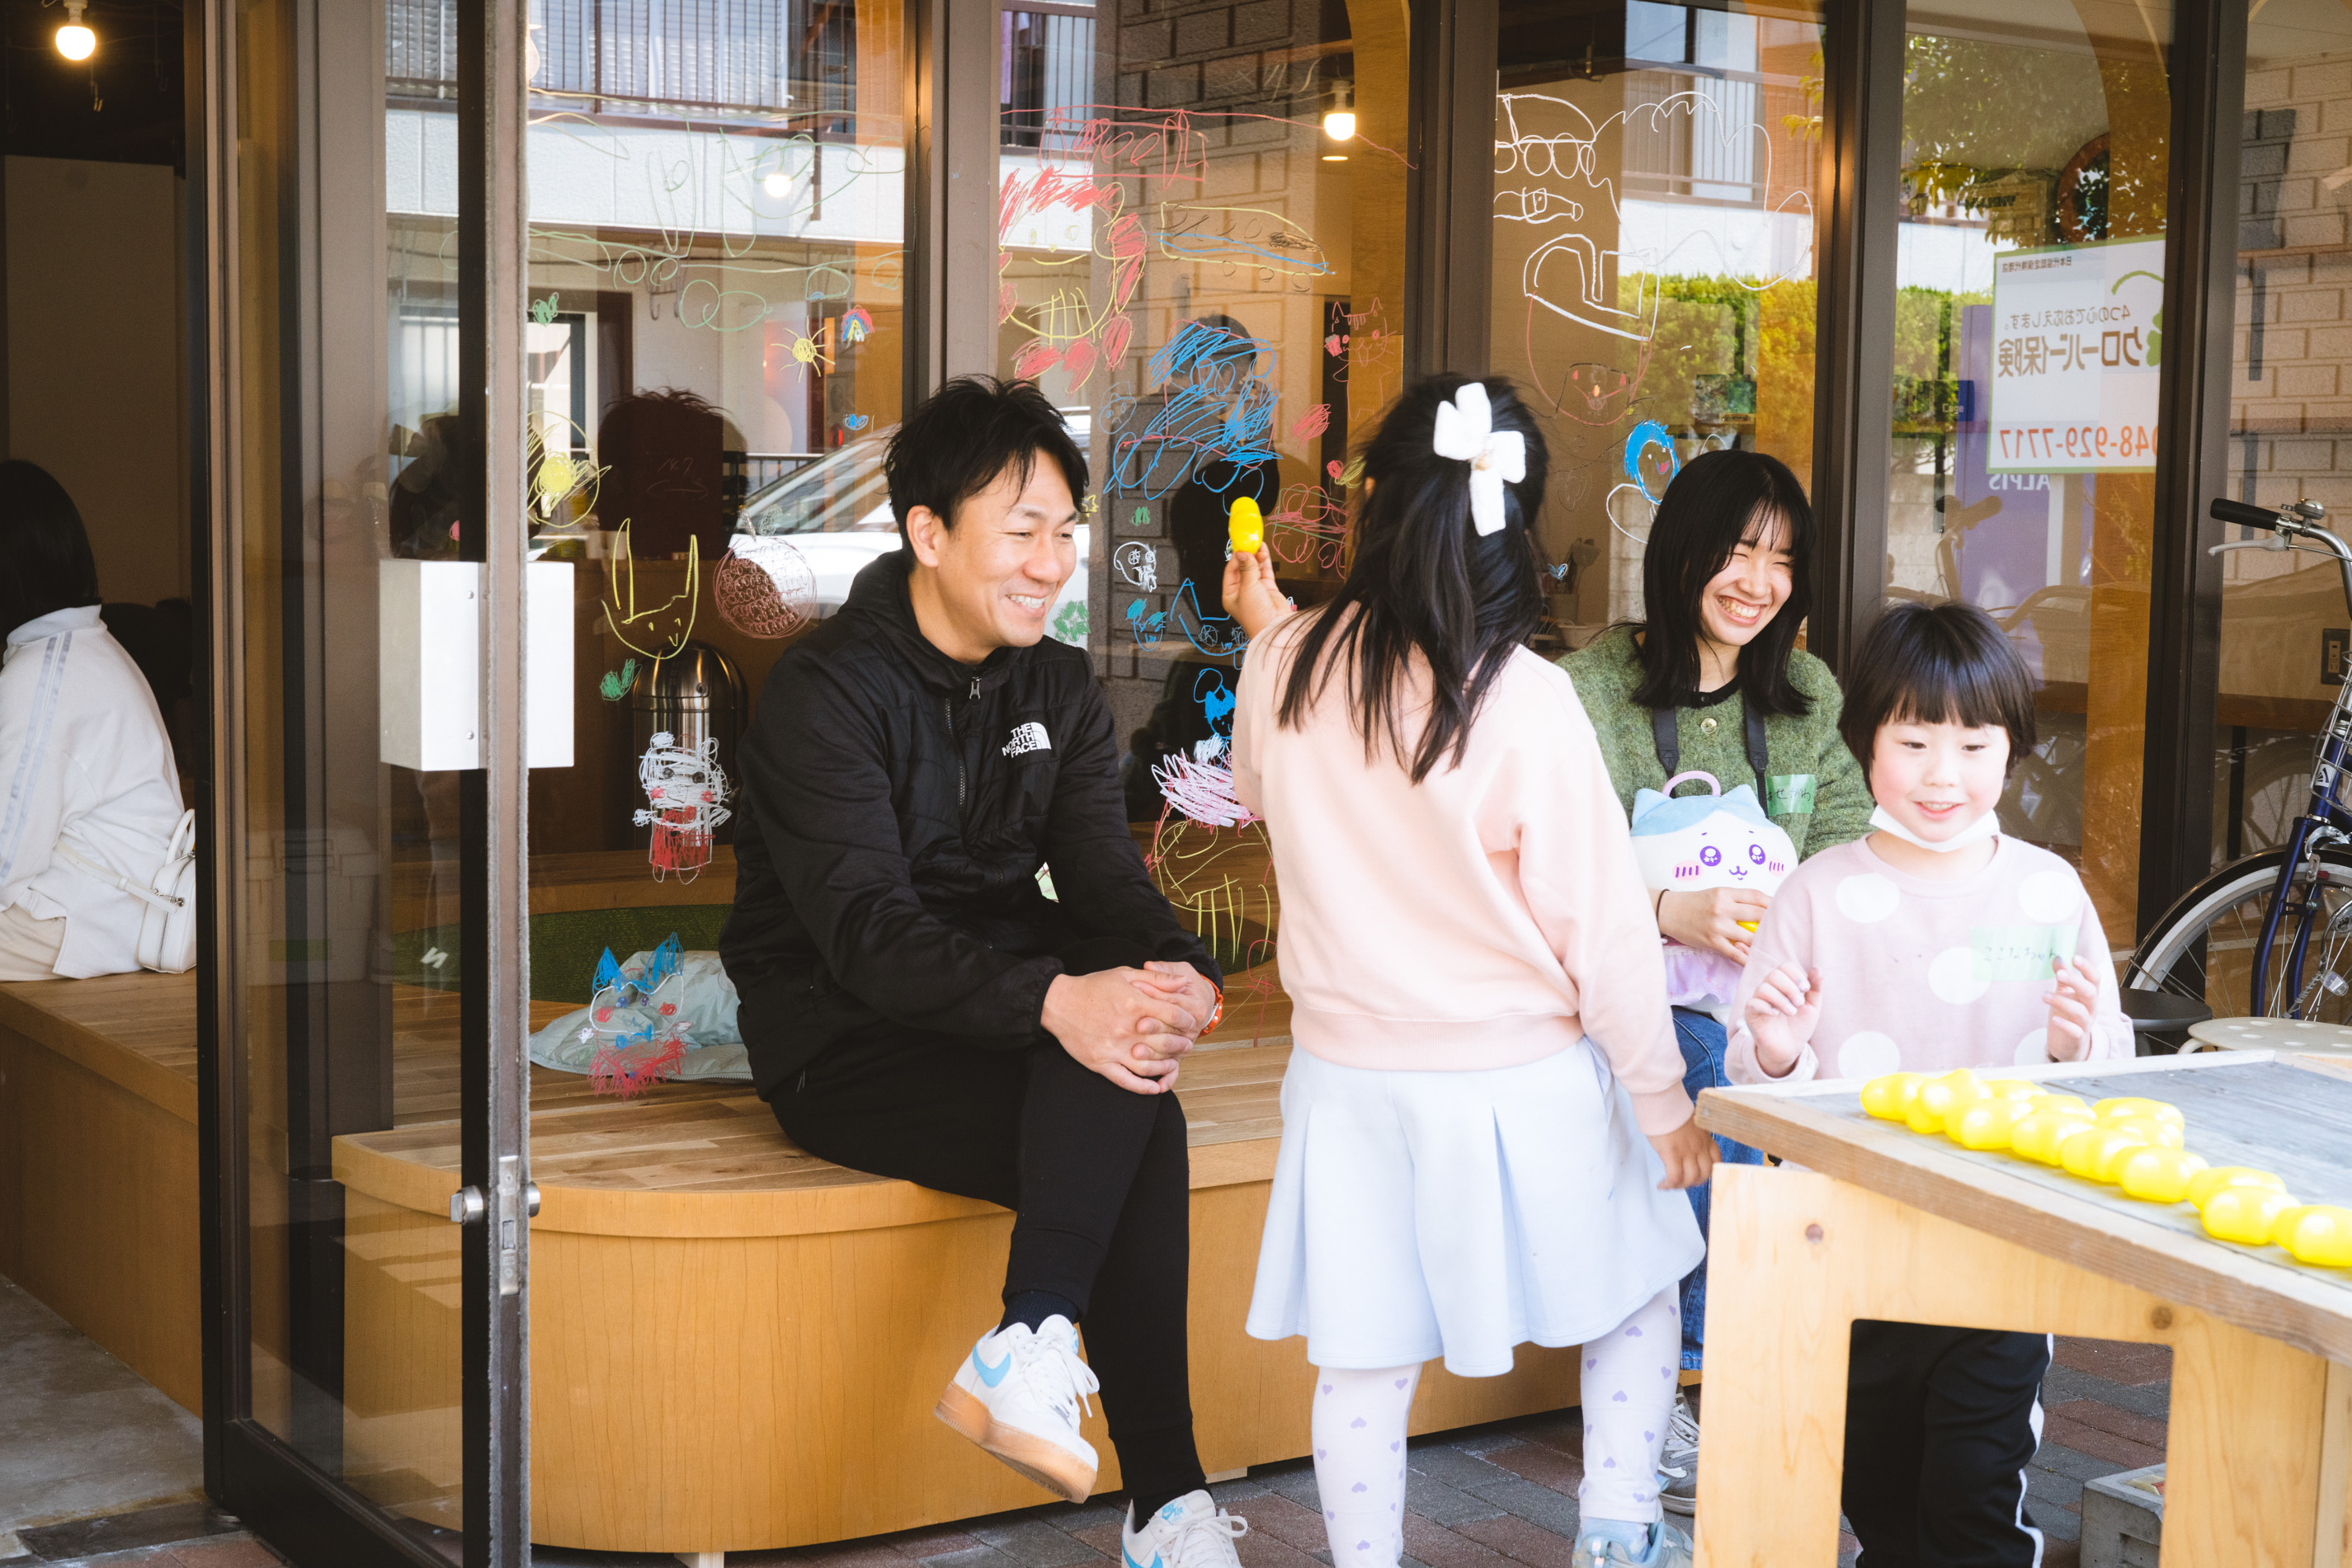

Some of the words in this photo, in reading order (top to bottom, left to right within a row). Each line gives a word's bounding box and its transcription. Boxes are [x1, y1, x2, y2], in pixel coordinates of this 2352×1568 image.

[1010, 723, 1031, 737] THE
[1002, 731, 1035, 756] NORTH
[1011, 740, 1038, 759] FACE
